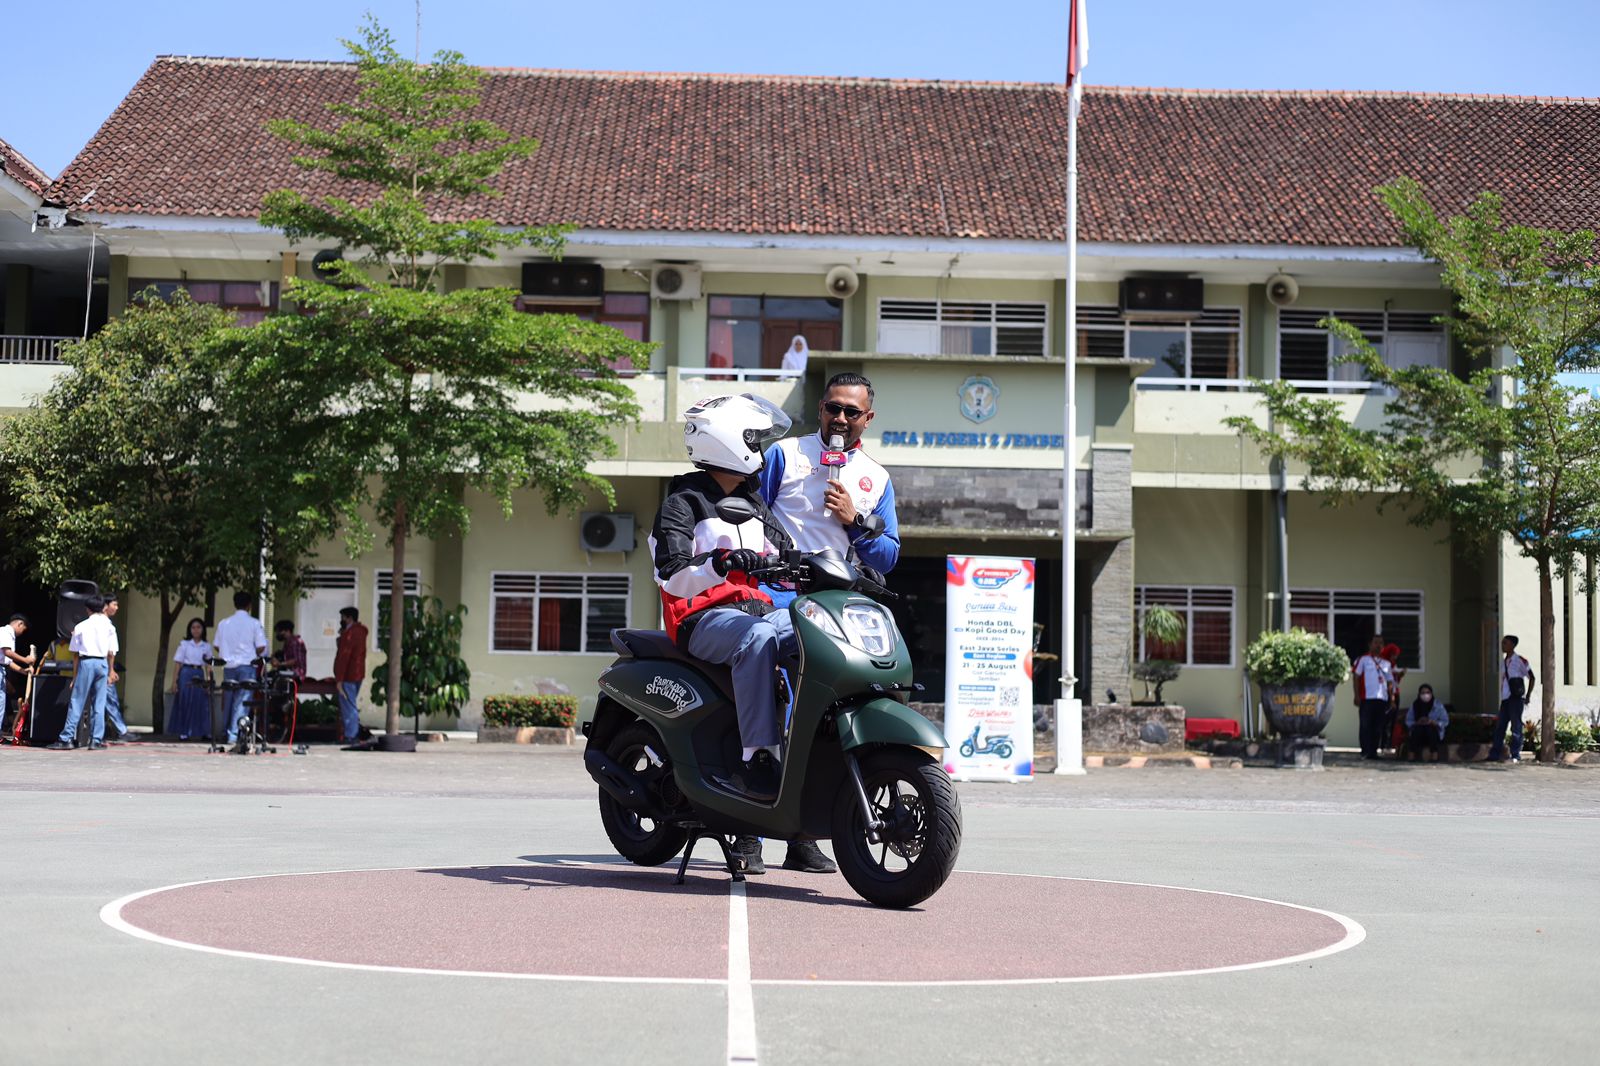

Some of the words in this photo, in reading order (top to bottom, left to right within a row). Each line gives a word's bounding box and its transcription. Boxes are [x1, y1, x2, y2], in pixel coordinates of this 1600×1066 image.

[882, 431, 918, 447] SMA
[923, 432, 986, 448] NEGERI
[988, 433, 1001, 448] 2
[1002, 433, 1065, 449] JEMBE
[1010, 628, 1026, 636] Day
[645, 683, 689, 712] Strolling
